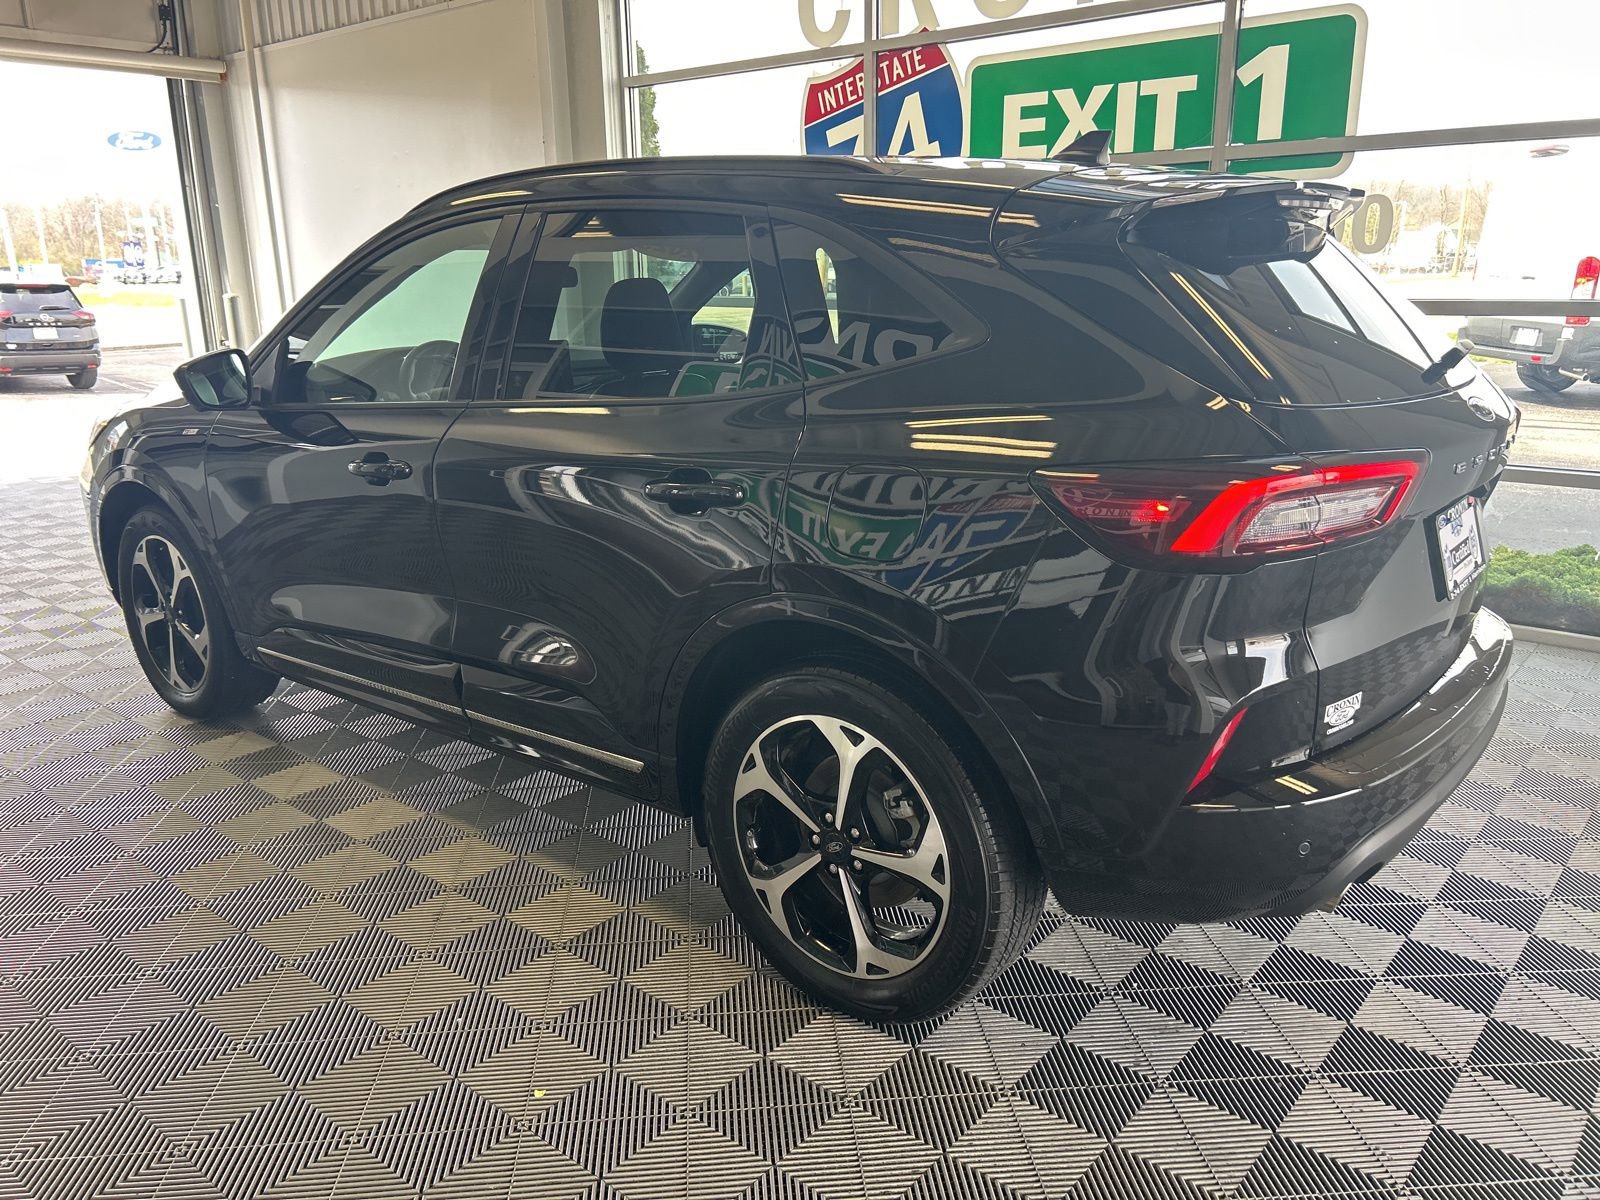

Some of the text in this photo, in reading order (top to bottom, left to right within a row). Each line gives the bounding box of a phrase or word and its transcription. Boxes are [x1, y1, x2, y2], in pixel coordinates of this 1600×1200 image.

[818, 47, 926, 115] INTERTATE
[1000, 45, 1289, 159] EXIT 1
[1326, 693, 1361, 718] CRONIN
